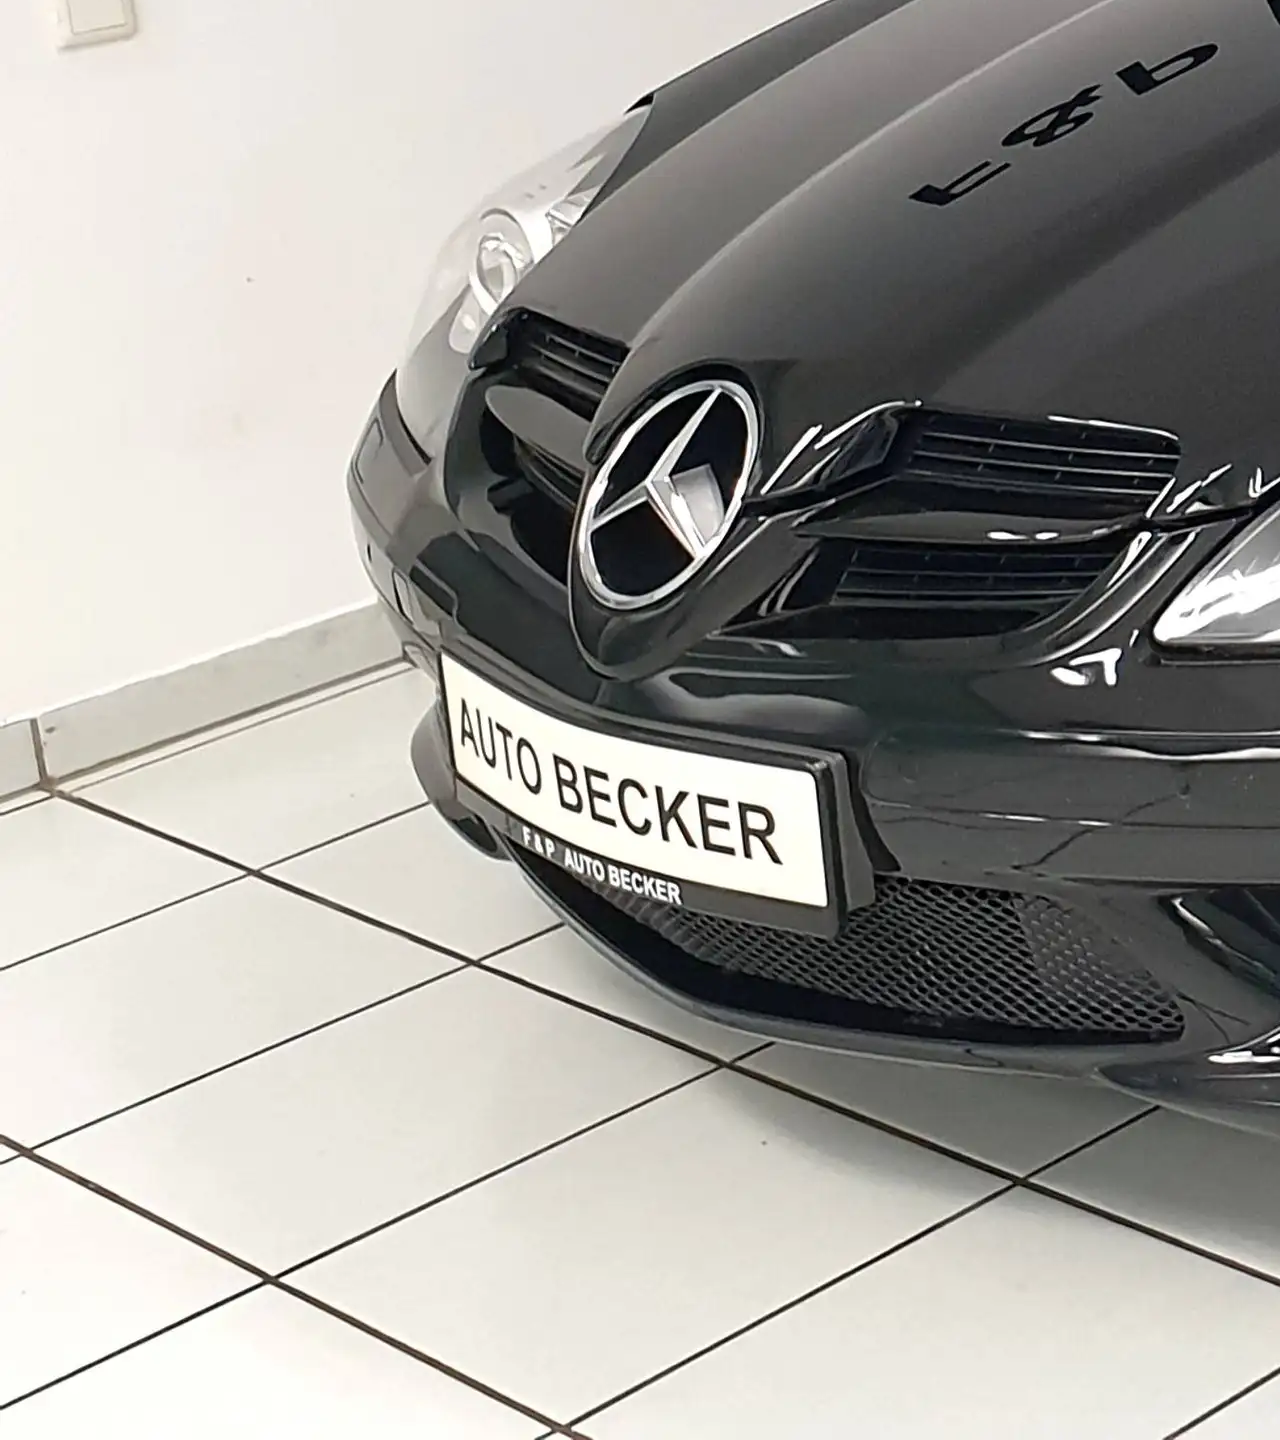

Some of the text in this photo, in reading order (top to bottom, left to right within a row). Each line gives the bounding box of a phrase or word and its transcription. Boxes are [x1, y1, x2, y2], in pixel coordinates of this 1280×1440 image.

[459, 697, 783, 866] AUTO BECKER
[564, 847, 606, 883] AUTO
[607, 863, 684, 906] BECKER
